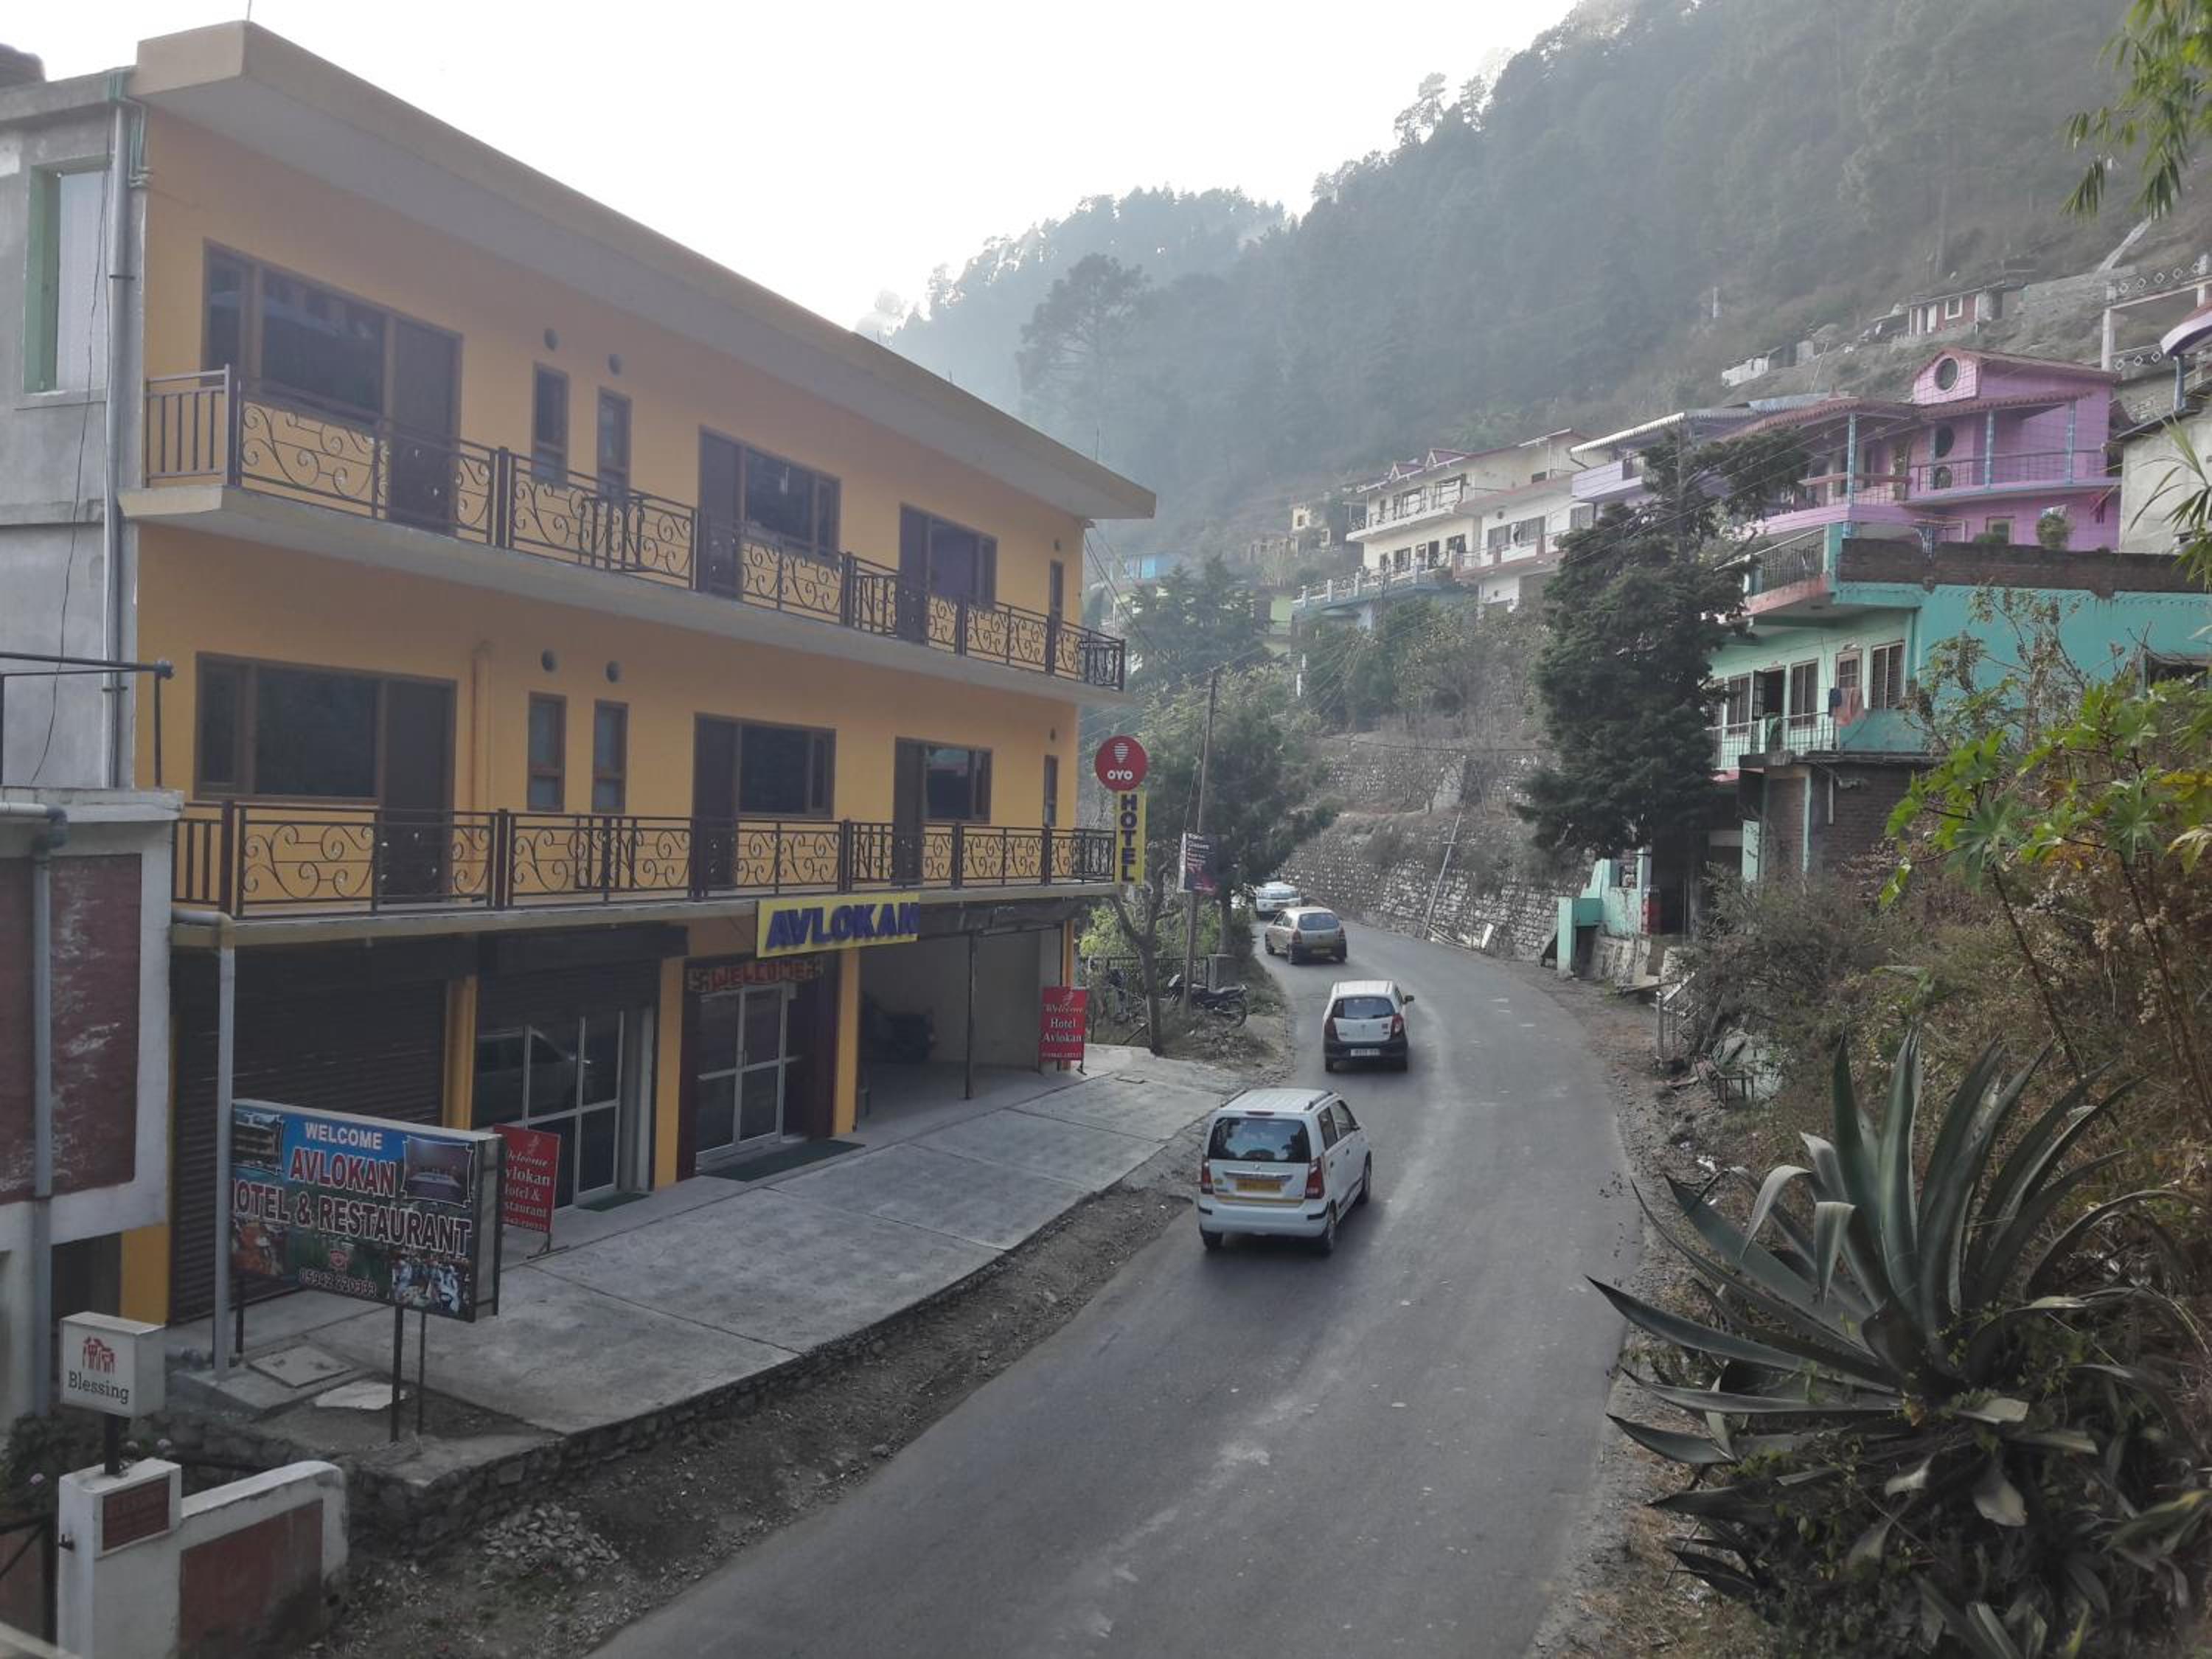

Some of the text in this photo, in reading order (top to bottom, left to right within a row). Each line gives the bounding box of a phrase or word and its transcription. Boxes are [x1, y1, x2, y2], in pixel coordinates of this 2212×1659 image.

[1107, 769, 1133, 782] OYO
[1119, 793, 1139, 883] HOTEL
[766, 902, 920, 950] AVLOKAN
[1043, 1032, 1082, 1043] Avlokan
[1050, 1017, 1077, 1029] Hotel
[305, 1121, 383, 1150] WELCOME
[288, 1147, 397, 1198] AVLOKAN
[506, 1166, 551, 1187] vlokan
[531, 1188, 542, 1202] &
[295, 1192, 312, 1228] &
[318, 1194, 473, 1257] RESTAURANT
[68, 1370, 130, 1405] Blessing
